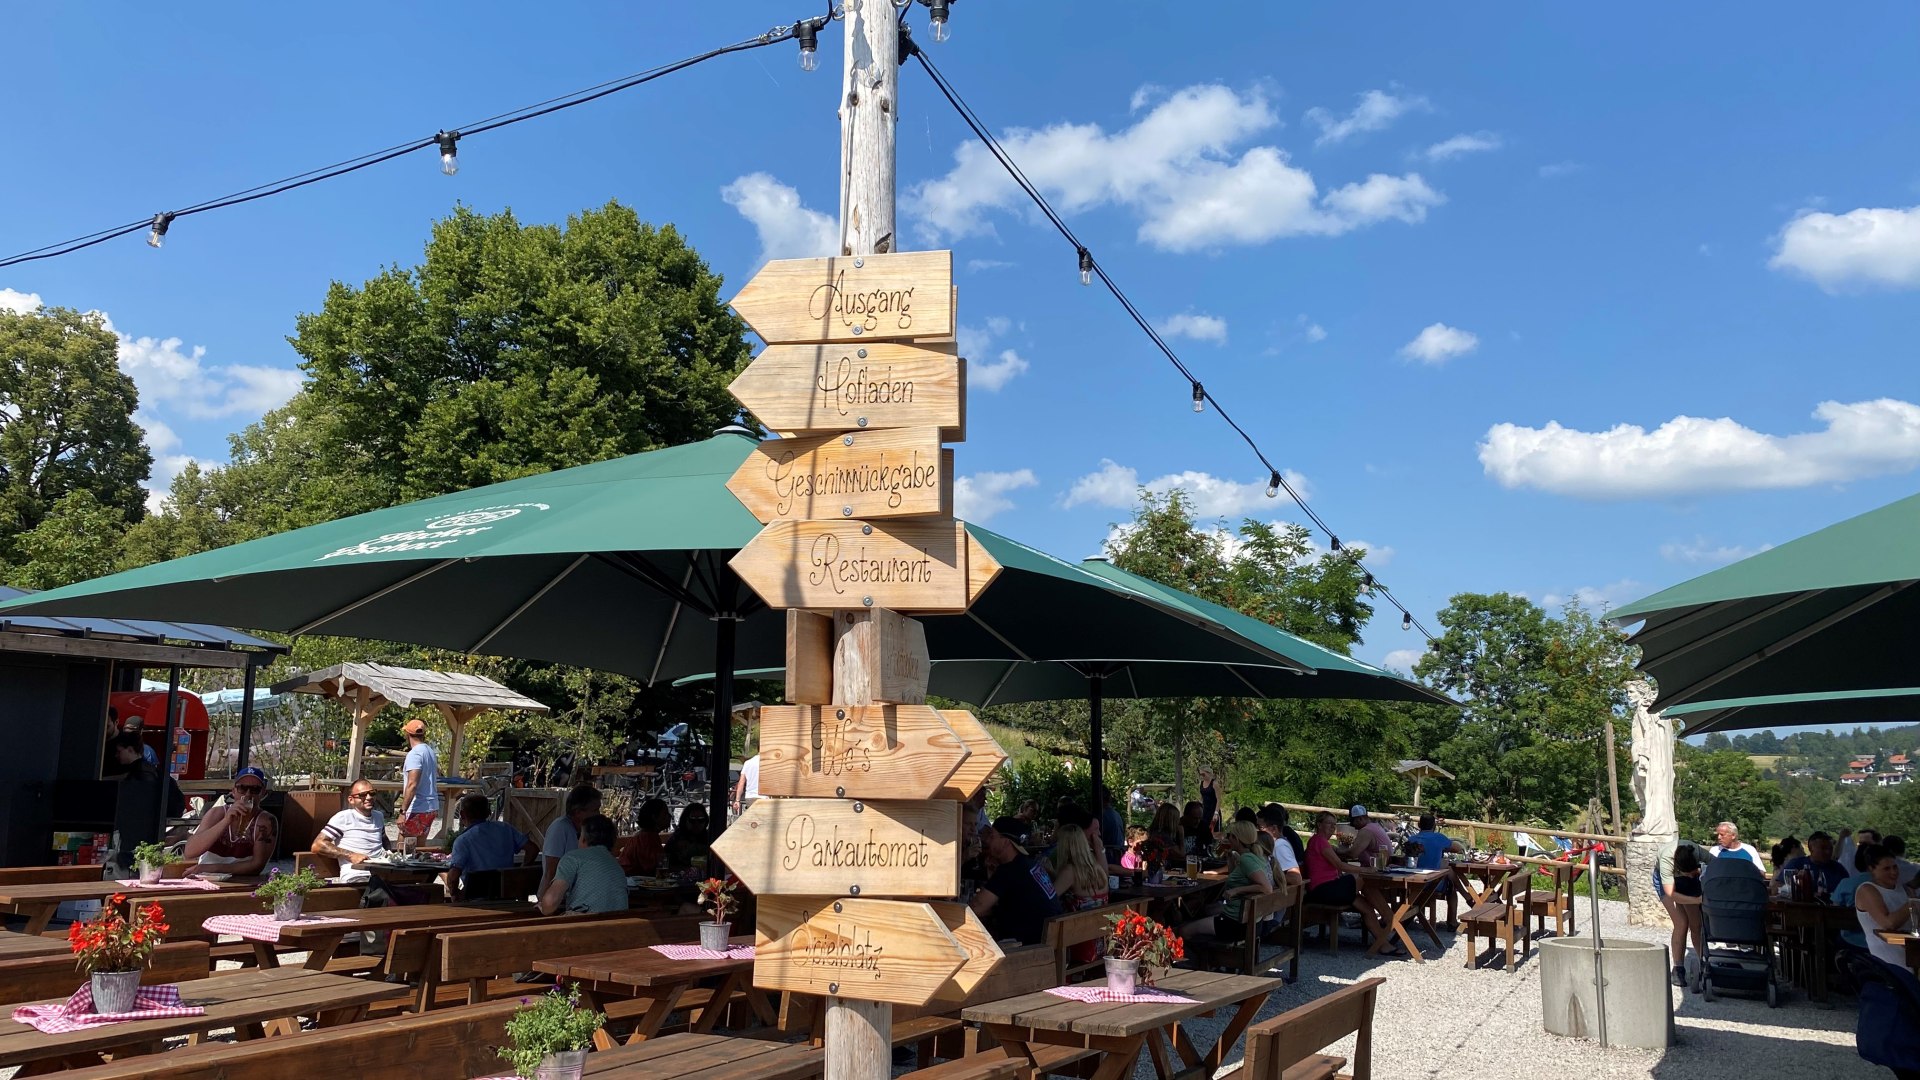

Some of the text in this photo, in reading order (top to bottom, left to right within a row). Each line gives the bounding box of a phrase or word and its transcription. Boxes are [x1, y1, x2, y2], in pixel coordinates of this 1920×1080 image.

[808, 269, 915, 331] Ausgang
[817, 356, 914, 416] Hofladen
[765, 450, 936, 516] Geschirrrückgabe
[809, 533, 932, 595] Restaurant
[782, 813, 929, 871] Parkautomat
